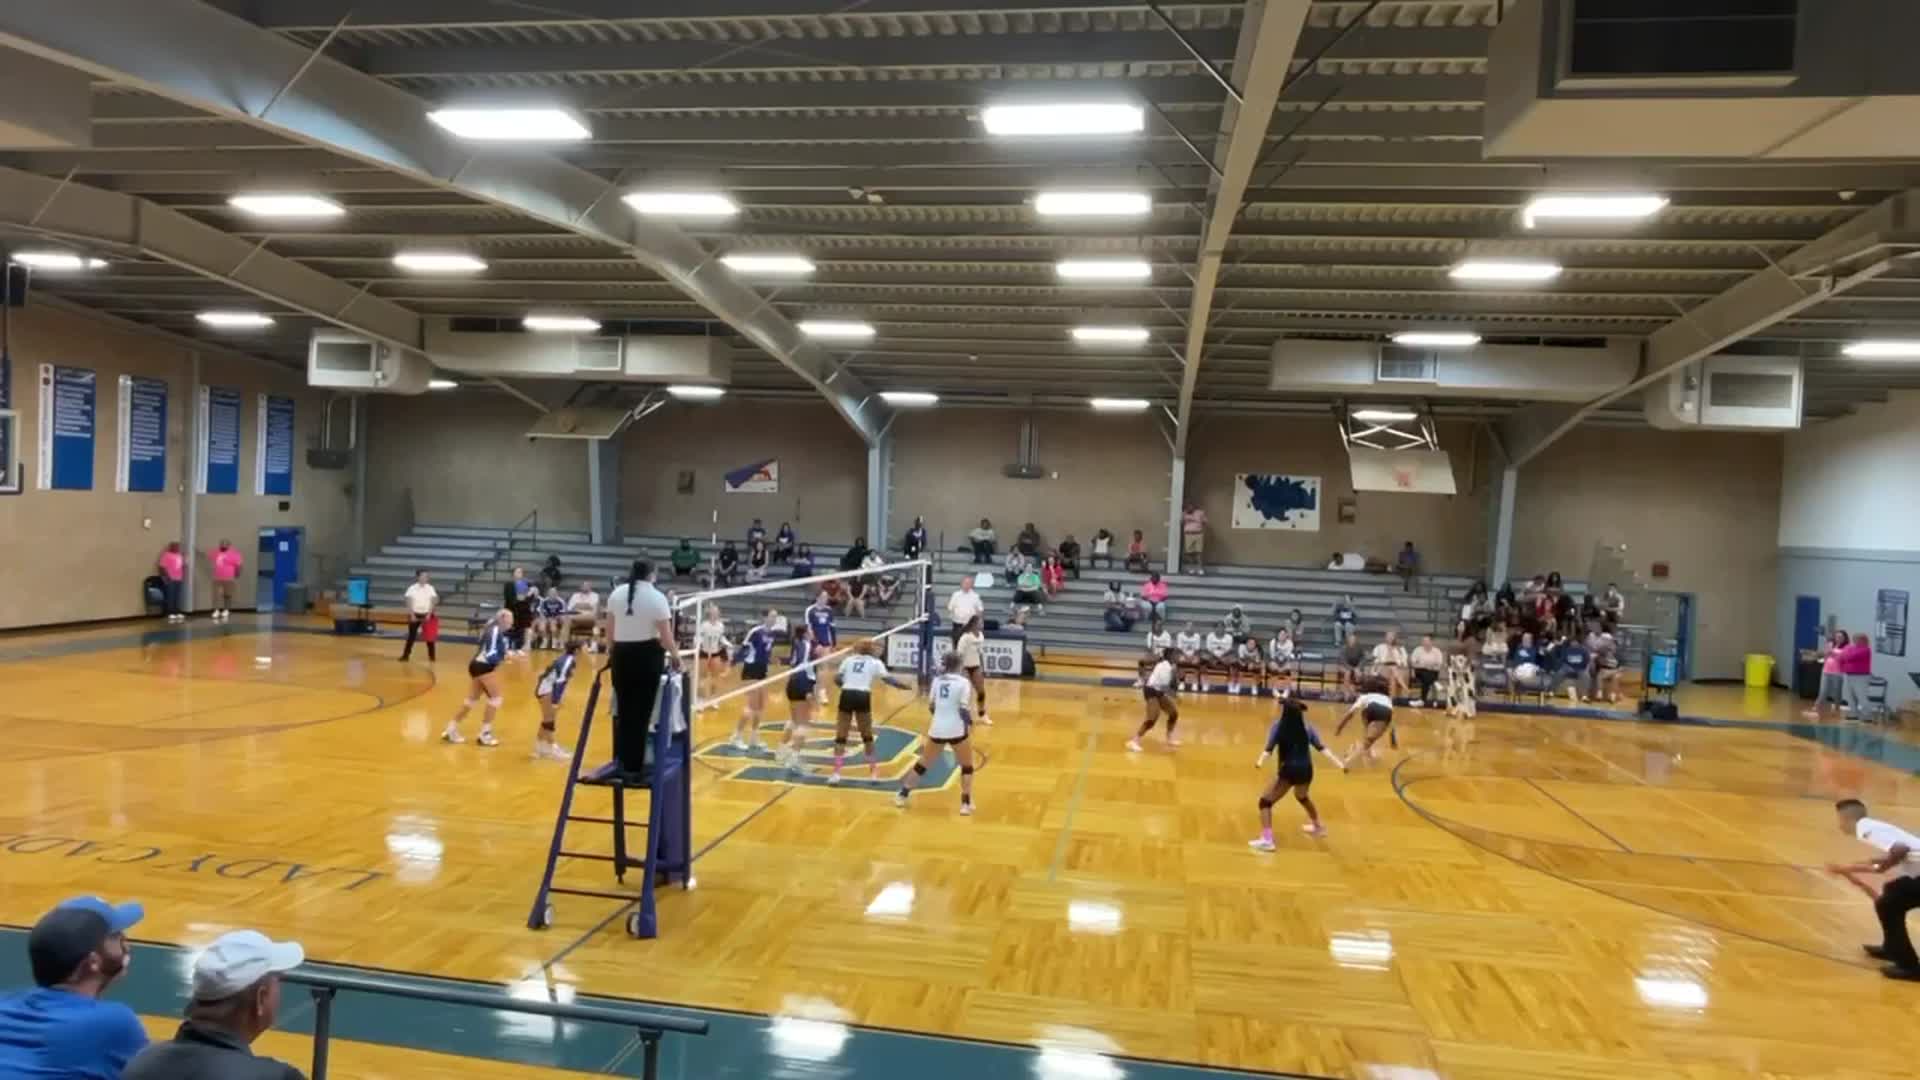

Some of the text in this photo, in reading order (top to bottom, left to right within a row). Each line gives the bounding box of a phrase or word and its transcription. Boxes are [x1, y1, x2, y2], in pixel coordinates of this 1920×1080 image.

[852, 661, 866, 673] 12
[940, 683, 951, 699] 15
[152, 853, 390, 891] LADY
